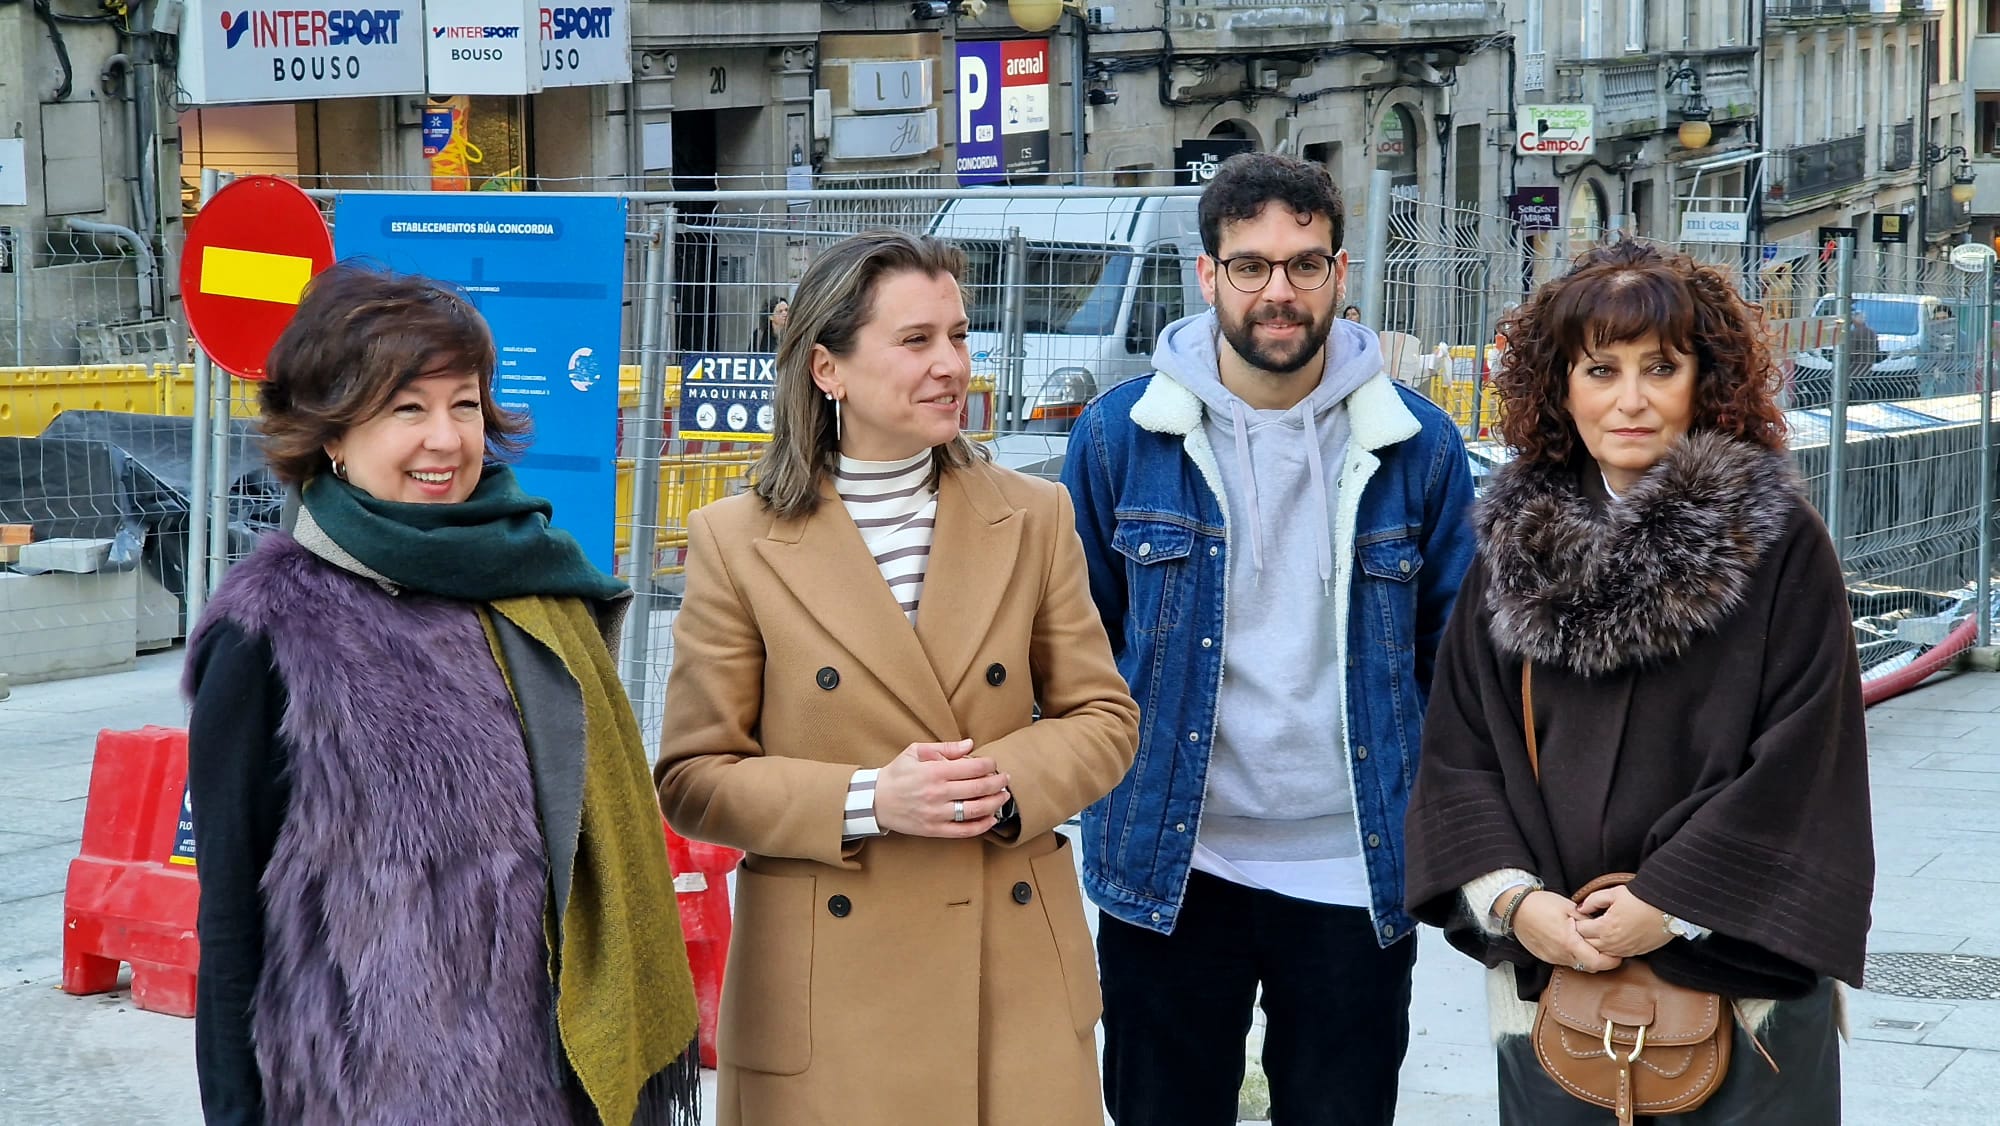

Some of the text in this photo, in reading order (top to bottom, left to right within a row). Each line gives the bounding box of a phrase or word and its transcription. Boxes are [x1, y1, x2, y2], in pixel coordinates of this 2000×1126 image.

[253, 9, 401, 48] INTERSPORT
[447, 26, 520, 38] INTERSPORT
[540, 7, 612, 40] RSPORT
[452, 49, 503, 60] BOUSO
[541, 48, 579, 70] USO
[1007, 51, 1043, 75] arenal
[274, 56, 360, 81] BOUSO
[710, 67, 726, 94] 20
[960, 56, 987, 143] P
[1520, 132, 1590, 154] Campos
[957, 155, 998, 171] CONCORDIA
[1186, 161, 1222, 182] TO
[391, 220, 553, 235] ESTABLECEMENTOS RÚA CONCORDIA
[1687, 217, 1739, 230] mi casa
[687, 358, 777, 380] ARTEIX
[689, 389, 775, 399] MAQUINARI
